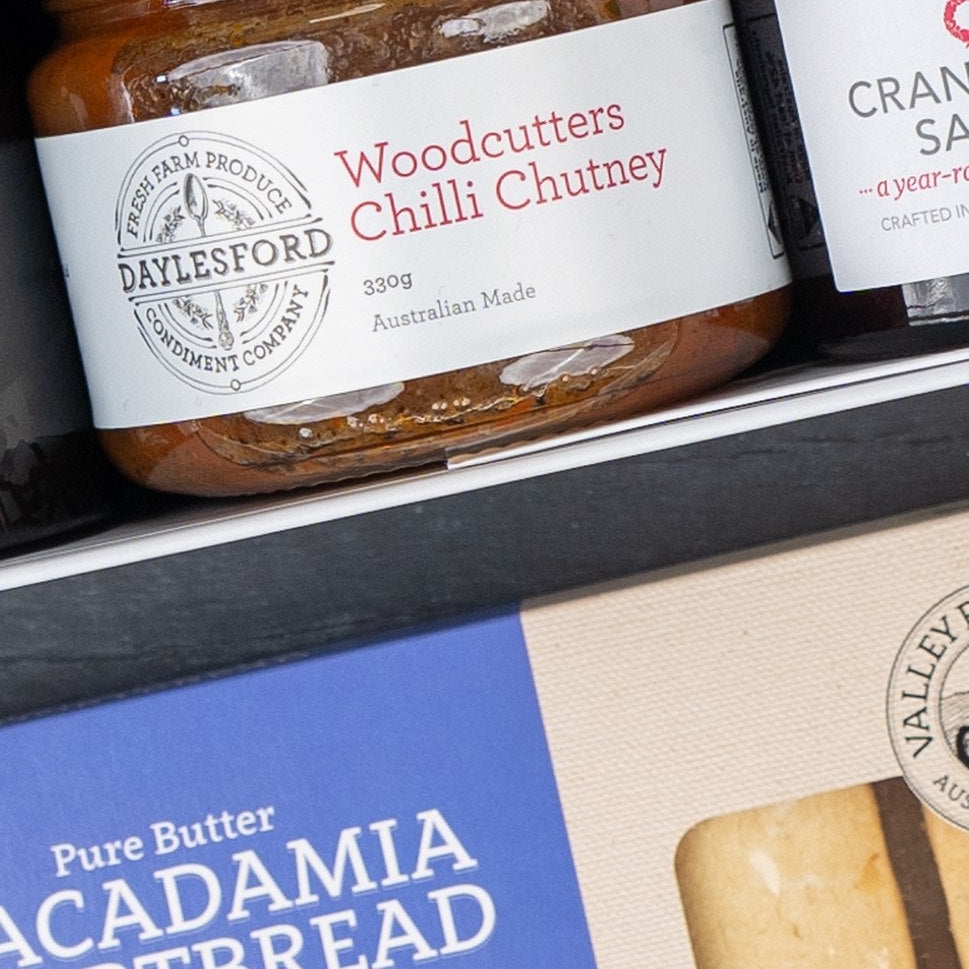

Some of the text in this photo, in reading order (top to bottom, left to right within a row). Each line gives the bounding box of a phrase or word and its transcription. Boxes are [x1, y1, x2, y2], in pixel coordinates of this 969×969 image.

[334, 102, 625, 188] Woodcutters
[126, 150, 292, 239] FRESH FARM PRODUCE
[350, 148, 667, 241] Chilli Chutney
[880, 207, 952, 232] CRAFTED
[118, 228, 333, 294] DAYLESFORD
[363, 271, 414, 296] 330g
[146, 285, 309, 373] CONDIMENT COMPANY
[371, 282, 537, 332] Australian Made
[901, 614, 958, 759] VALLEY
[50, 806, 277, 878] Pure Butter
